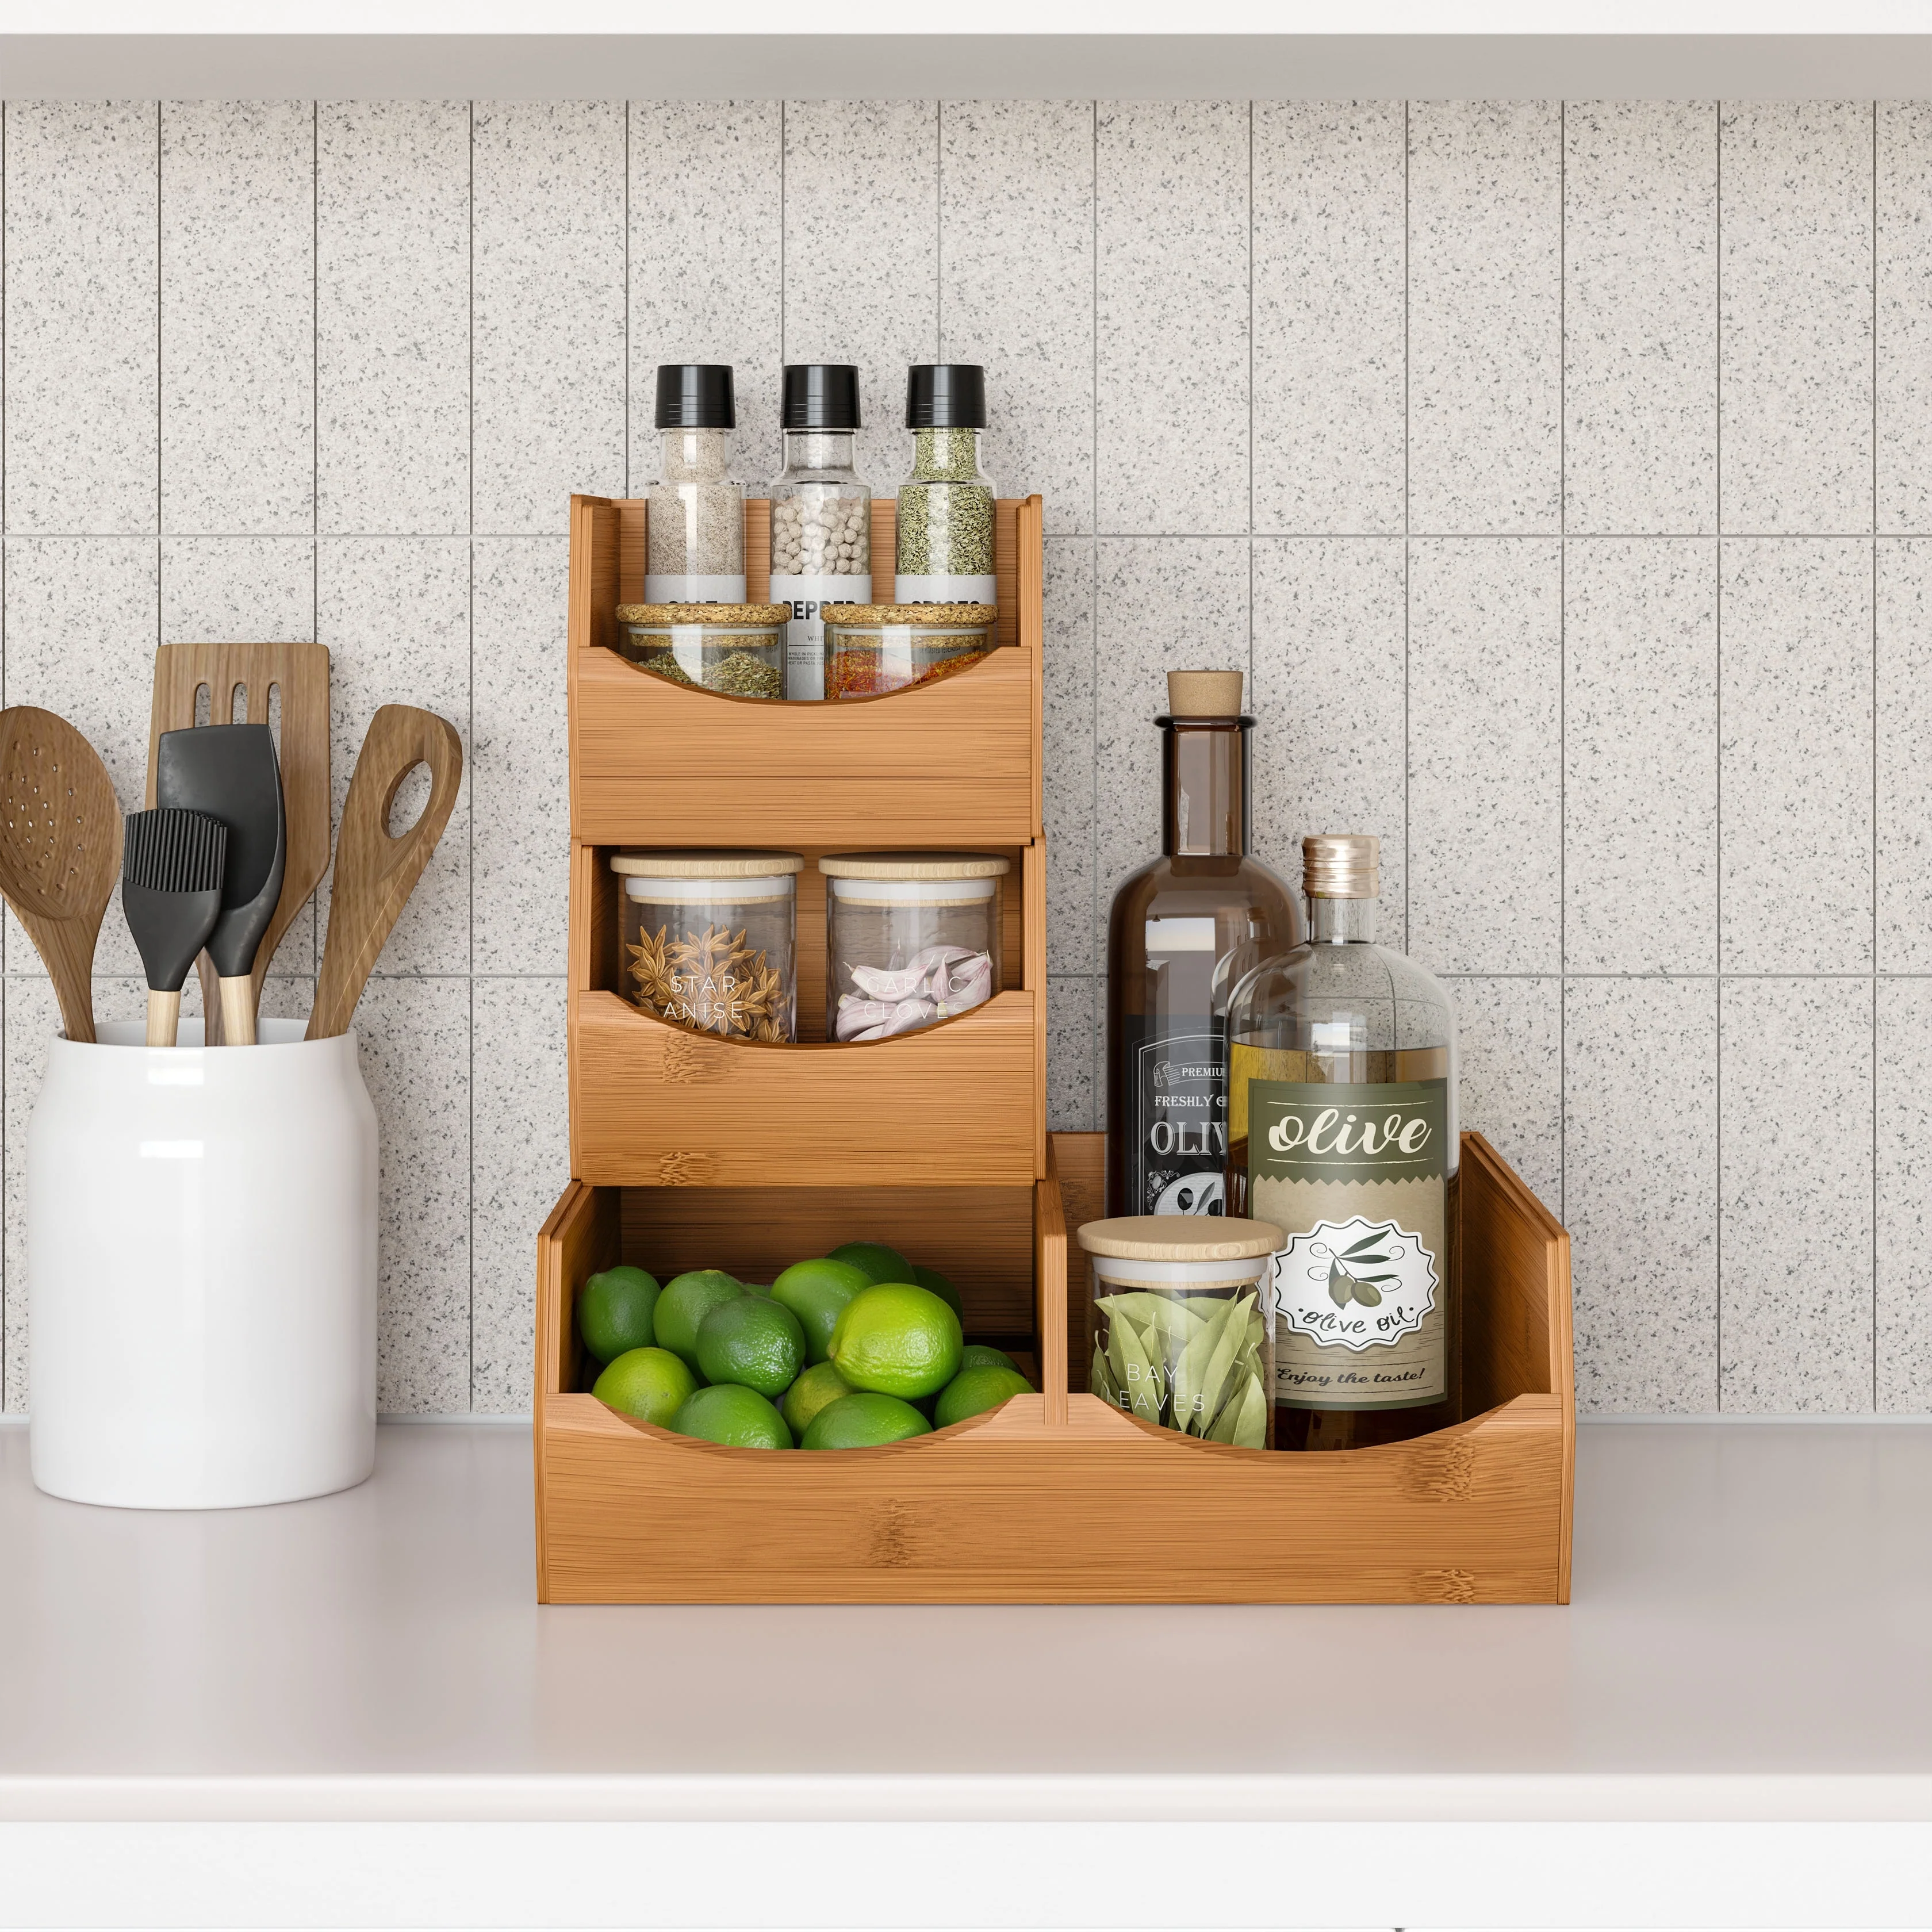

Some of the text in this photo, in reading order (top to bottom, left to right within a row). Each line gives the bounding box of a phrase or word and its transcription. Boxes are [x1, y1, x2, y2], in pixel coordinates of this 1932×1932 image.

[671, 976, 735, 992] STAR
[867, 976, 961, 993] GARLIC
[663, 1002, 742, 1019] ANISE
[864, 1002, 963, 1019] CLOVES
[1155, 1094, 1214, 1107] FRESHLY
[1268, 1108, 1432, 1155] olive
[1128, 1363, 1178, 1383] BAY
[1277, 1367, 1425, 1386] Enjoy the taste!
